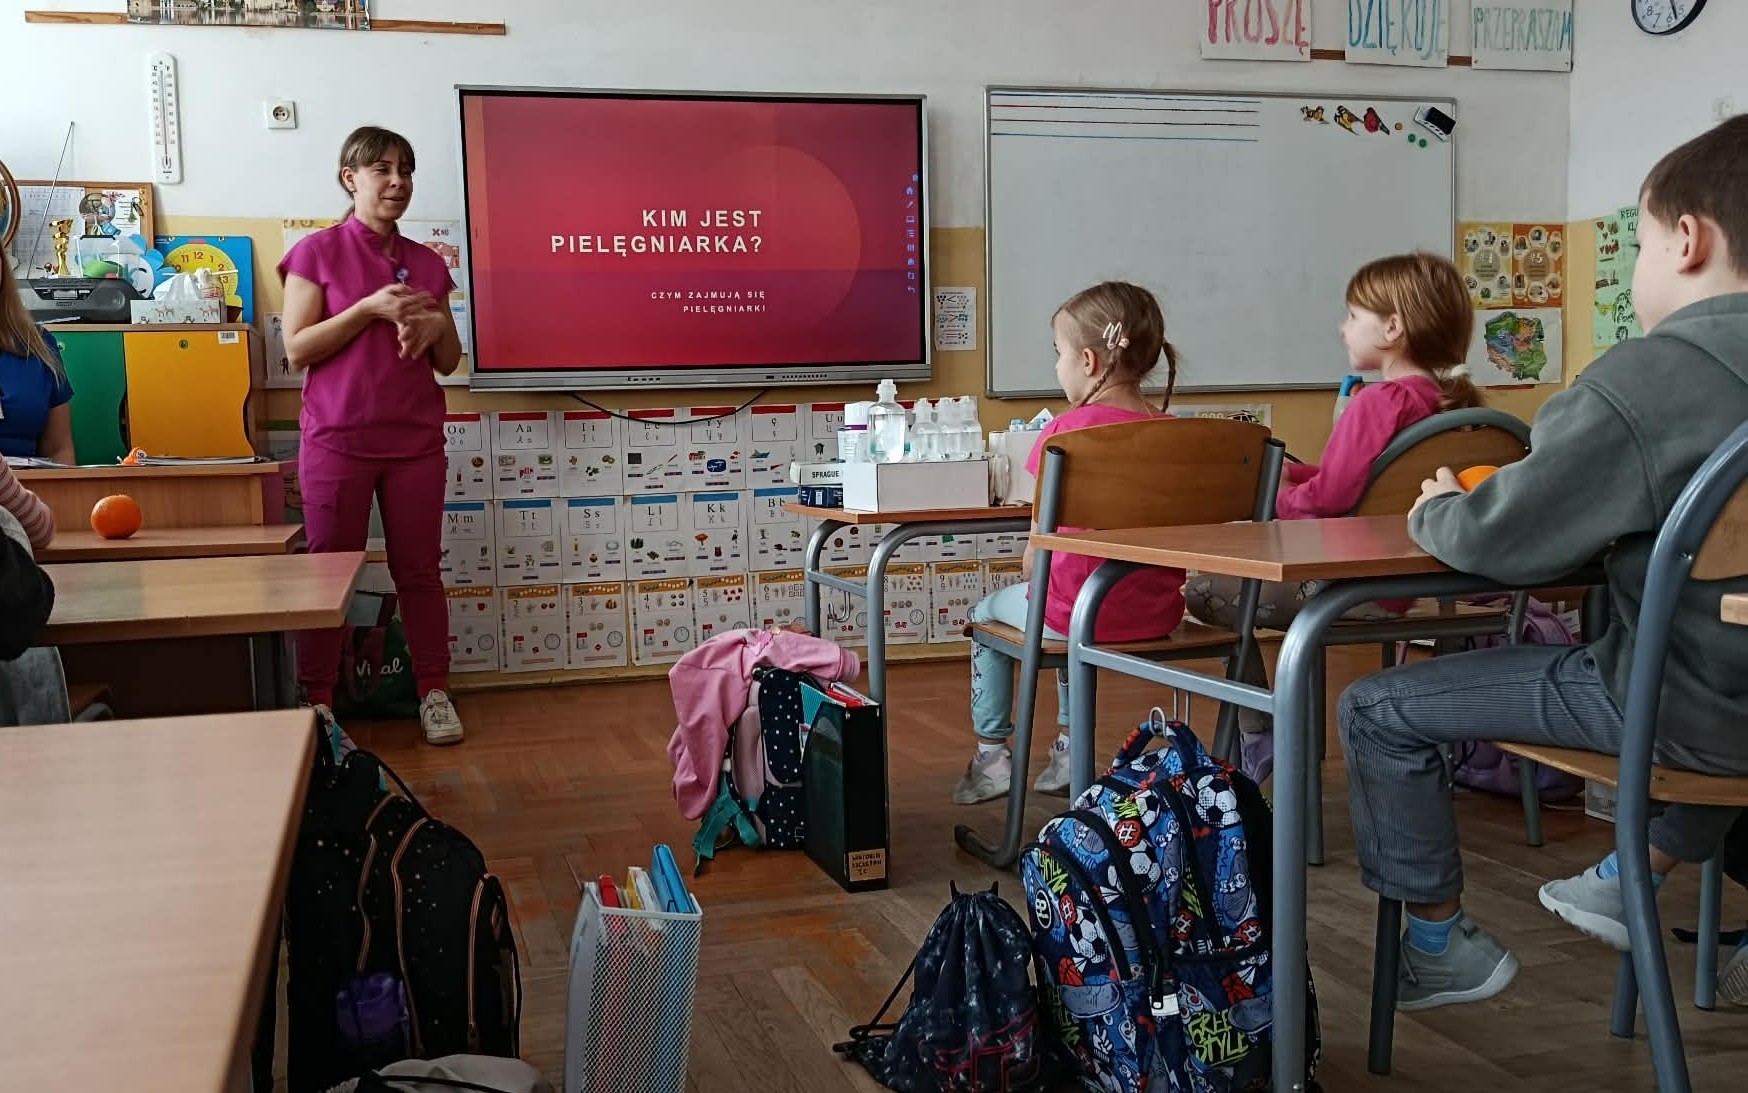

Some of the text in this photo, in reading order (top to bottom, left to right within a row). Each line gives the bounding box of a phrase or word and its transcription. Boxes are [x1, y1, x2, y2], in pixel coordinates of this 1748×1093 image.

[642, 209, 762, 227] KIM JEST
[551, 235, 762, 257] PIELĘGNIARKA?
[181, 254, 189, 263] 11
[193, 251, 204, 260] 12
[651, 290, 765, 300] CZYM ZAJMUJĄ SIĘ
[683, 305, 766, 314] PIELĘGNIARKI
[811, 470, 840, 479] SPRAGUE
[764, 585, 770, 593] 6
[356, 657, 403, 677] Vial
